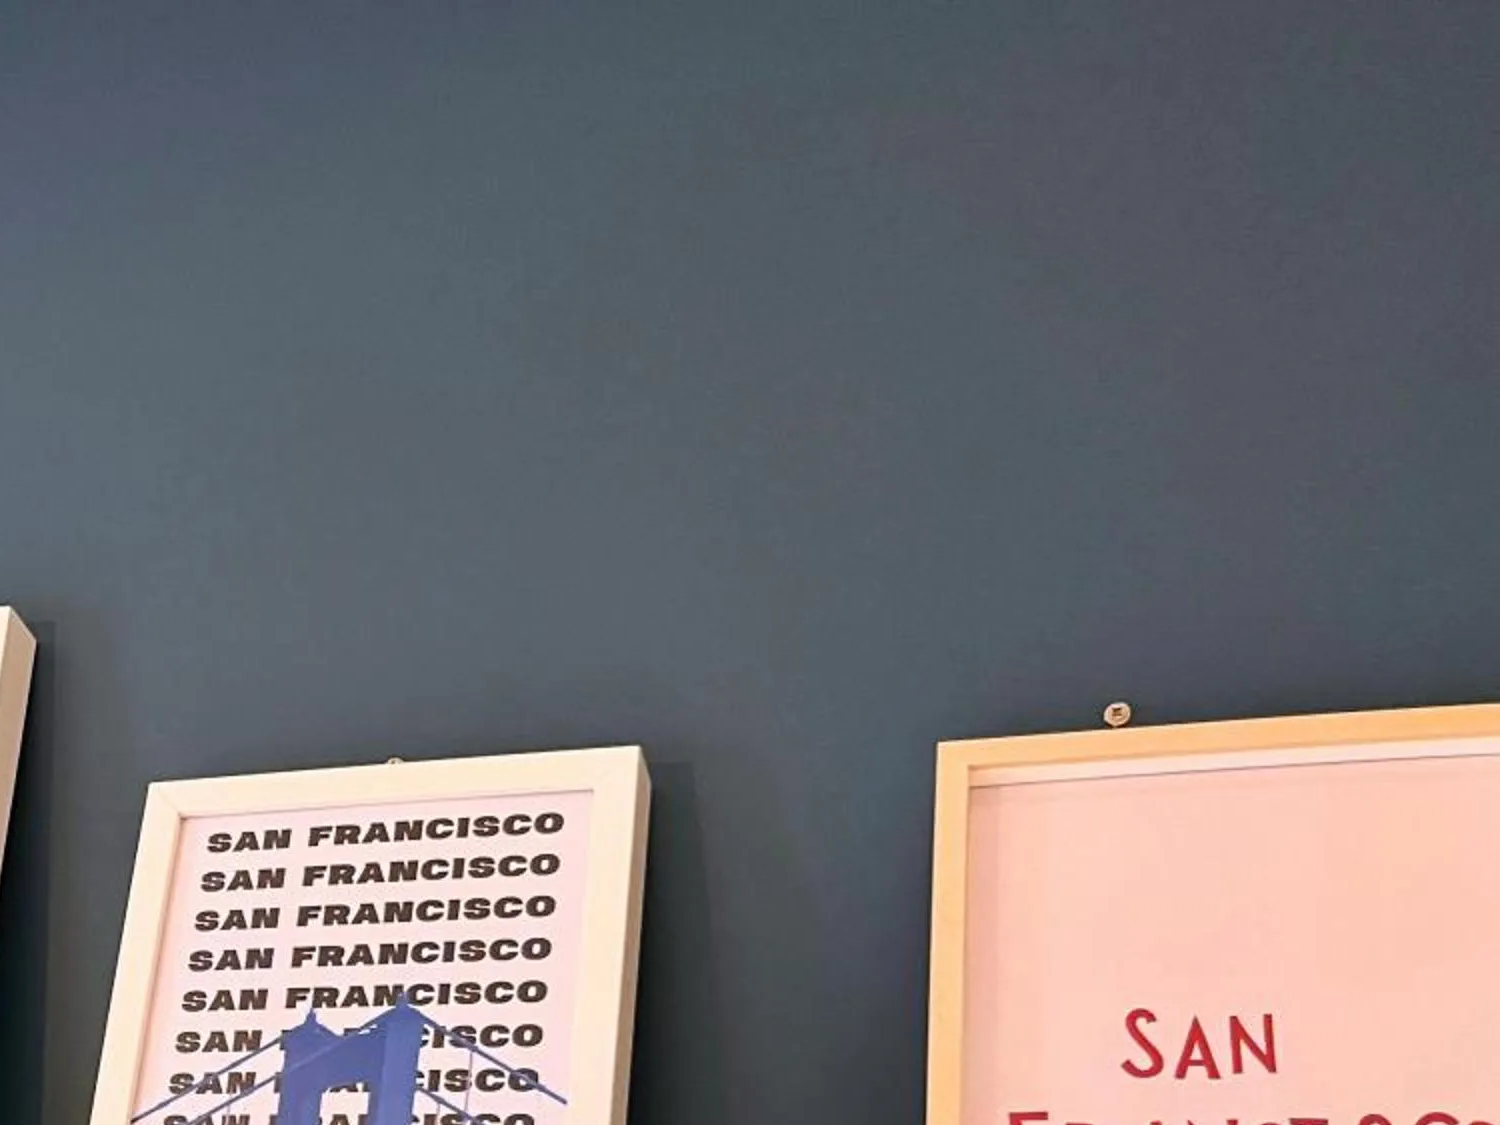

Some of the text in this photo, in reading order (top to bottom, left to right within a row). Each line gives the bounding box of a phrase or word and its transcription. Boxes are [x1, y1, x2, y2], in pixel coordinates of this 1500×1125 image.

[207, 813, 564, 853] SAN FRANCISCO
[201, 853, 560, 892] SAN FRANCISCO
[195, 895, 556, 931] SAN FRANCISCO
[188, 937, 552, 972] SAN FRANCISCO
[181, 980, 547, 1012] SAN FRANCISCO
[175, 1030, 262, 1054] SAN
[1120, 1007, 1278, 1080] SAN
[169, 1072, 257, 1096] SAN
